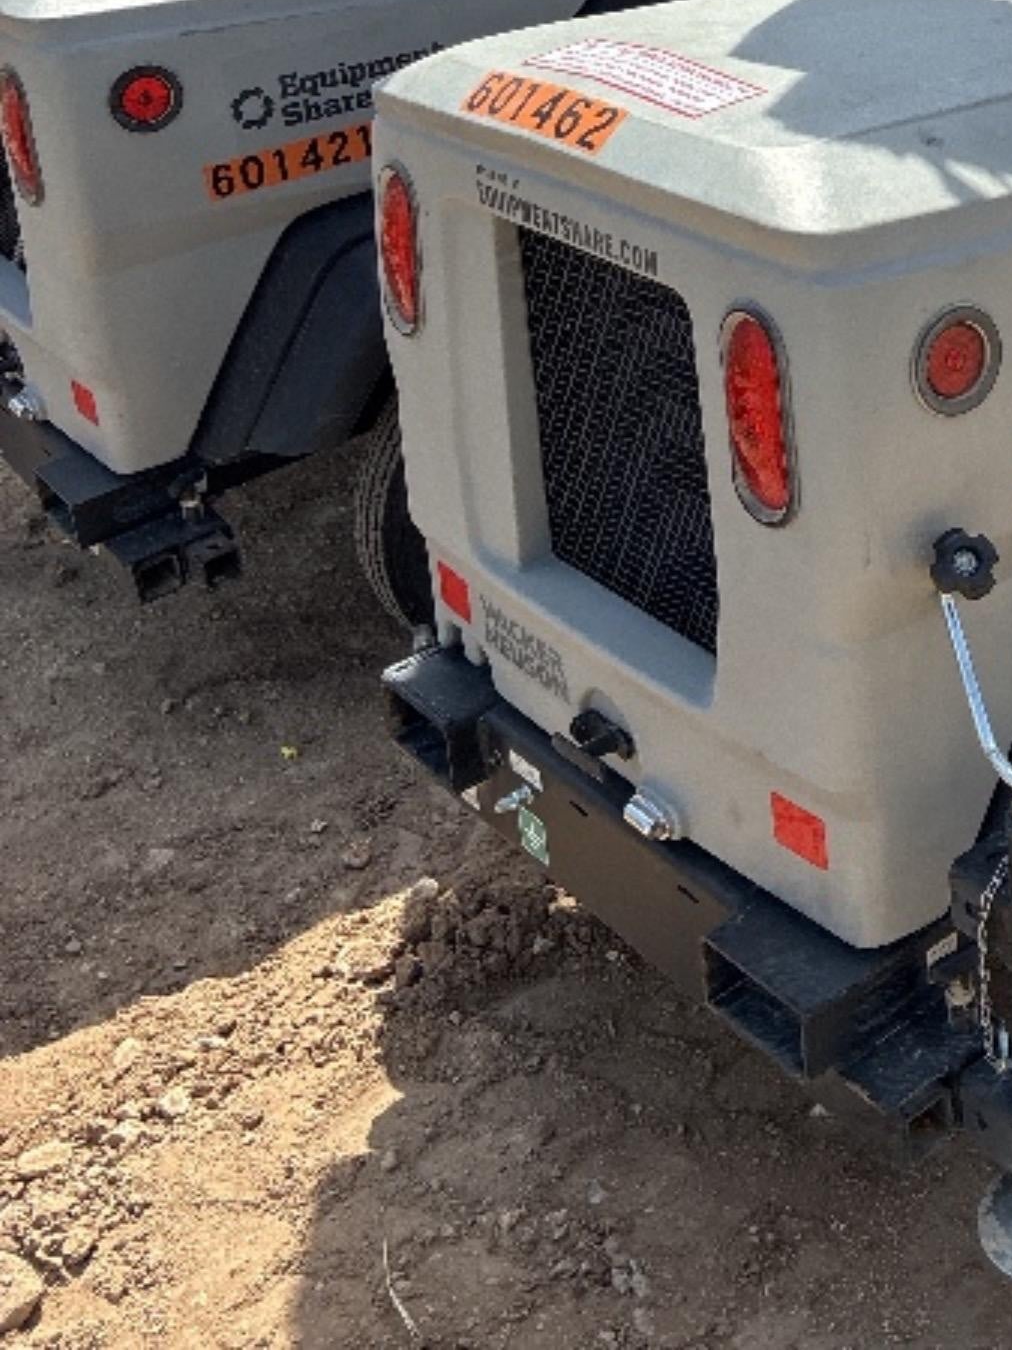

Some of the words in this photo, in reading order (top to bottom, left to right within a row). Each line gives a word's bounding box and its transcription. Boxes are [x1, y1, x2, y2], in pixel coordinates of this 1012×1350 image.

[281, 89, 373, 128] Share
[467, 72, 619, 151] 601462
[212, 125, 373, 199] 601421
